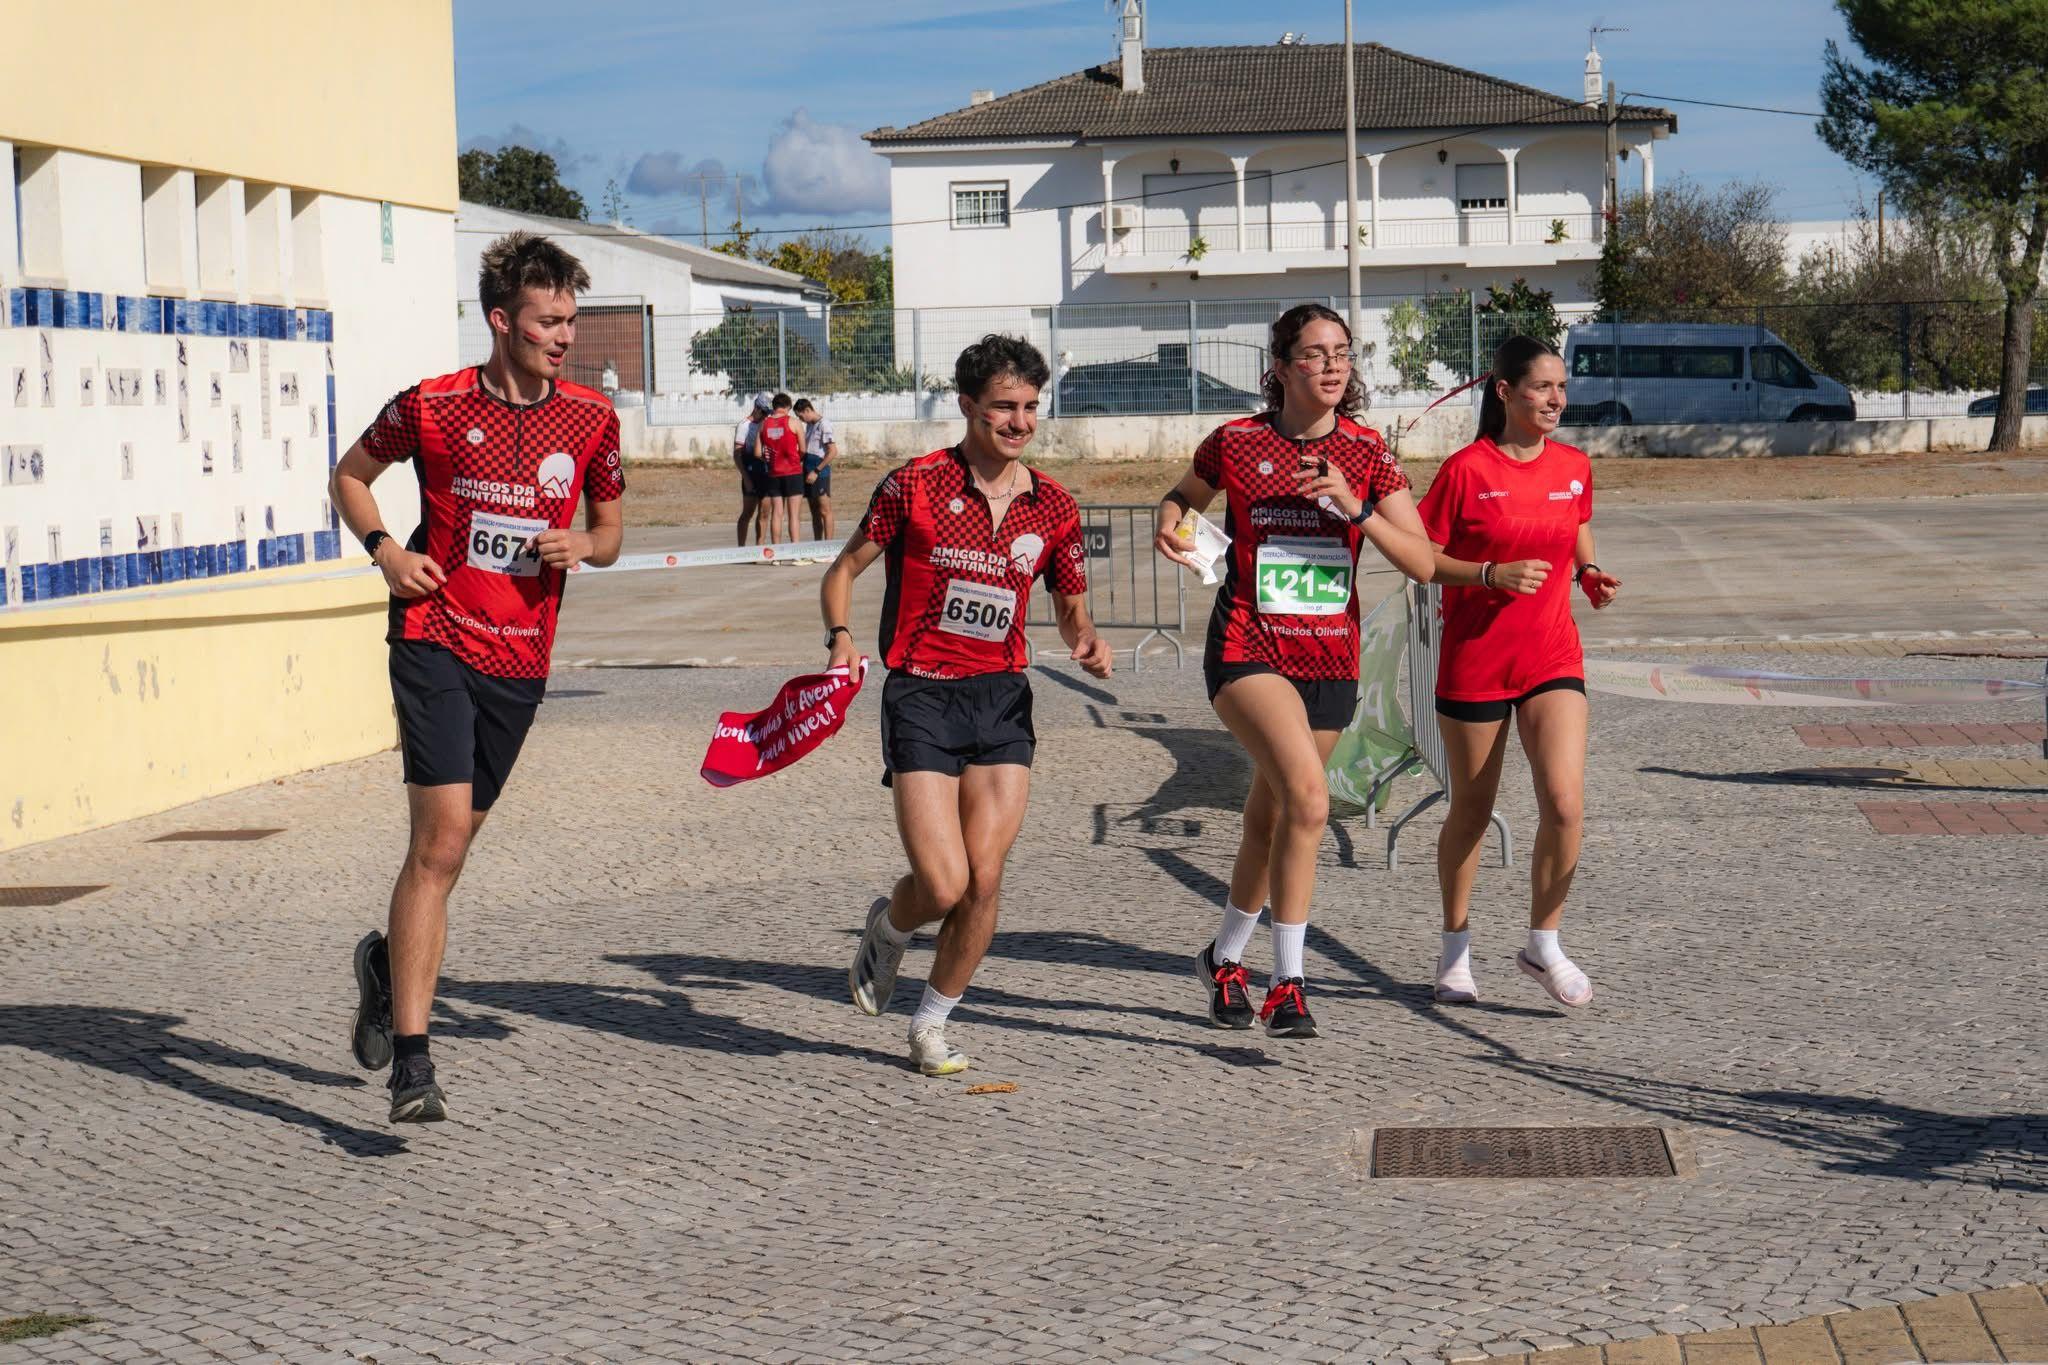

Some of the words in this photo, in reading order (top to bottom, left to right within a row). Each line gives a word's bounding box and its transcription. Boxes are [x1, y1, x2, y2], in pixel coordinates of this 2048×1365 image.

[450, 486, 535, 508] MONTANHA
[453, 477, 510, 494] AMIGOS
[513, 484, 535, 497] DA
[1250, 517, 1320, 528] MONTANHA
[1251, 507, 1298, 518] AMIGOS
[1301, 509, 1319, 519] DA
[929, 556, 1006, 578] MONTANHA
[932, 547, 986, 561] AMIGOS
[988, 553, 1007, 567] DA
[1262, 569, 1347, 598] 121-4
[947, 597, 1011, 630] 6506
[502, 625, 540, 637] Oliveira
[1315, 627, 1348, 637] Oliveira
[784, 690, 798, 720] de
[788, 701, 838, 745] viver!
